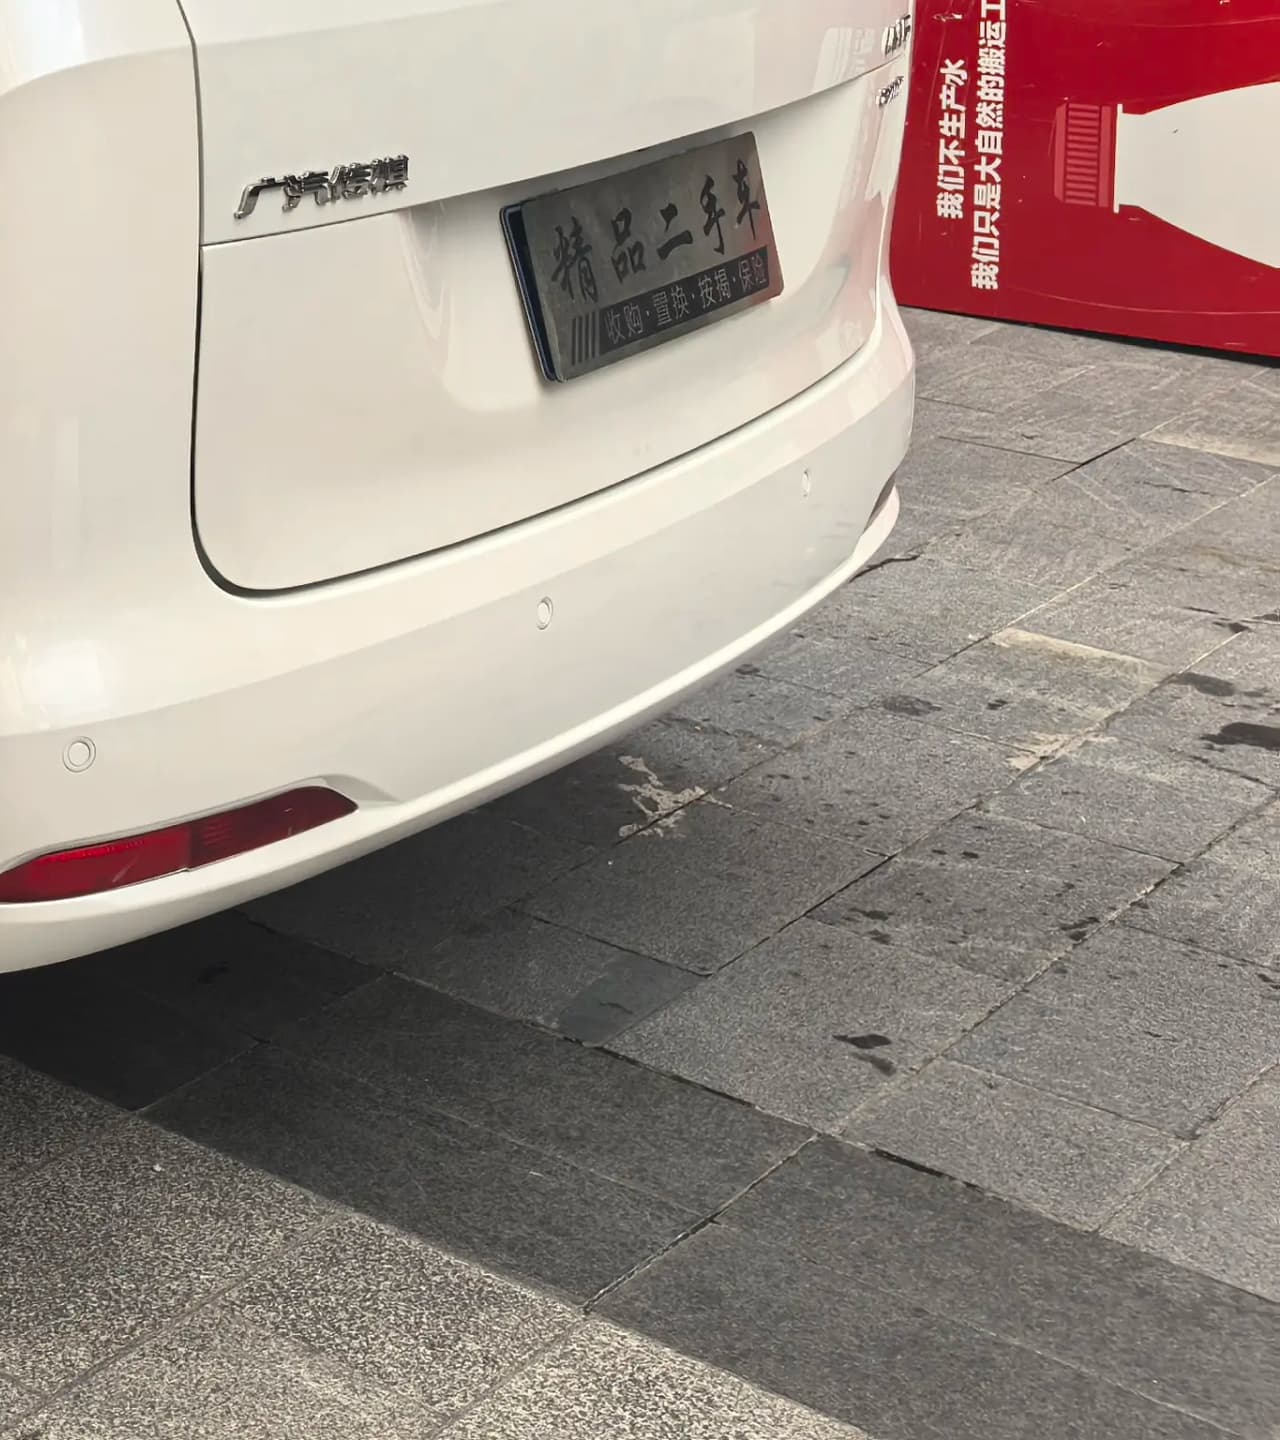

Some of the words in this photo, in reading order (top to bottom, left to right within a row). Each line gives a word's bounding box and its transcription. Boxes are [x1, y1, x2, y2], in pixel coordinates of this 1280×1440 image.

[936, 58, 969, 220] 我们不生产水
[550, 158, 761, 303] 精品二手车
